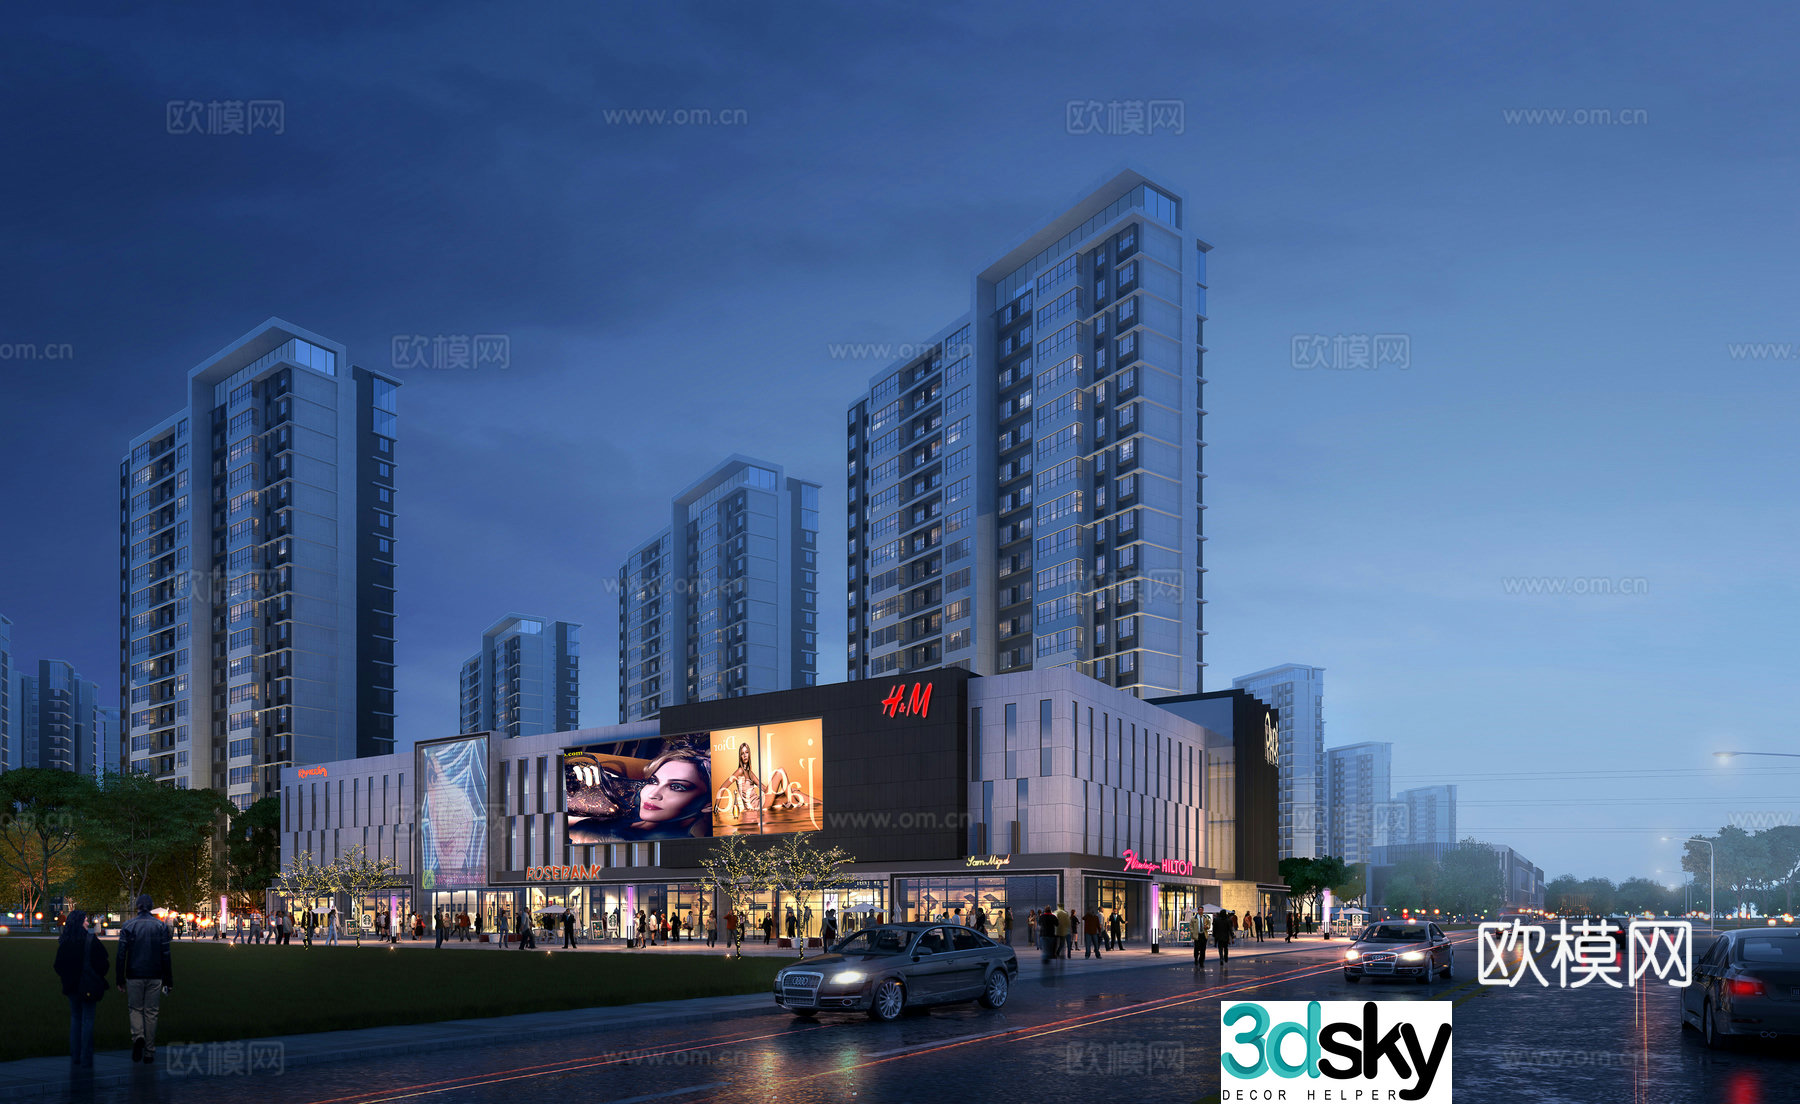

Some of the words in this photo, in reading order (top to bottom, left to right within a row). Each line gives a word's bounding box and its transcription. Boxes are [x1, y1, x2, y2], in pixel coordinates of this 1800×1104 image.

[881, 682, 933, 718] H&M
[526, 864, 601, 881] ROSEBANK
[1161, 858, 1193, 876] HILTON
